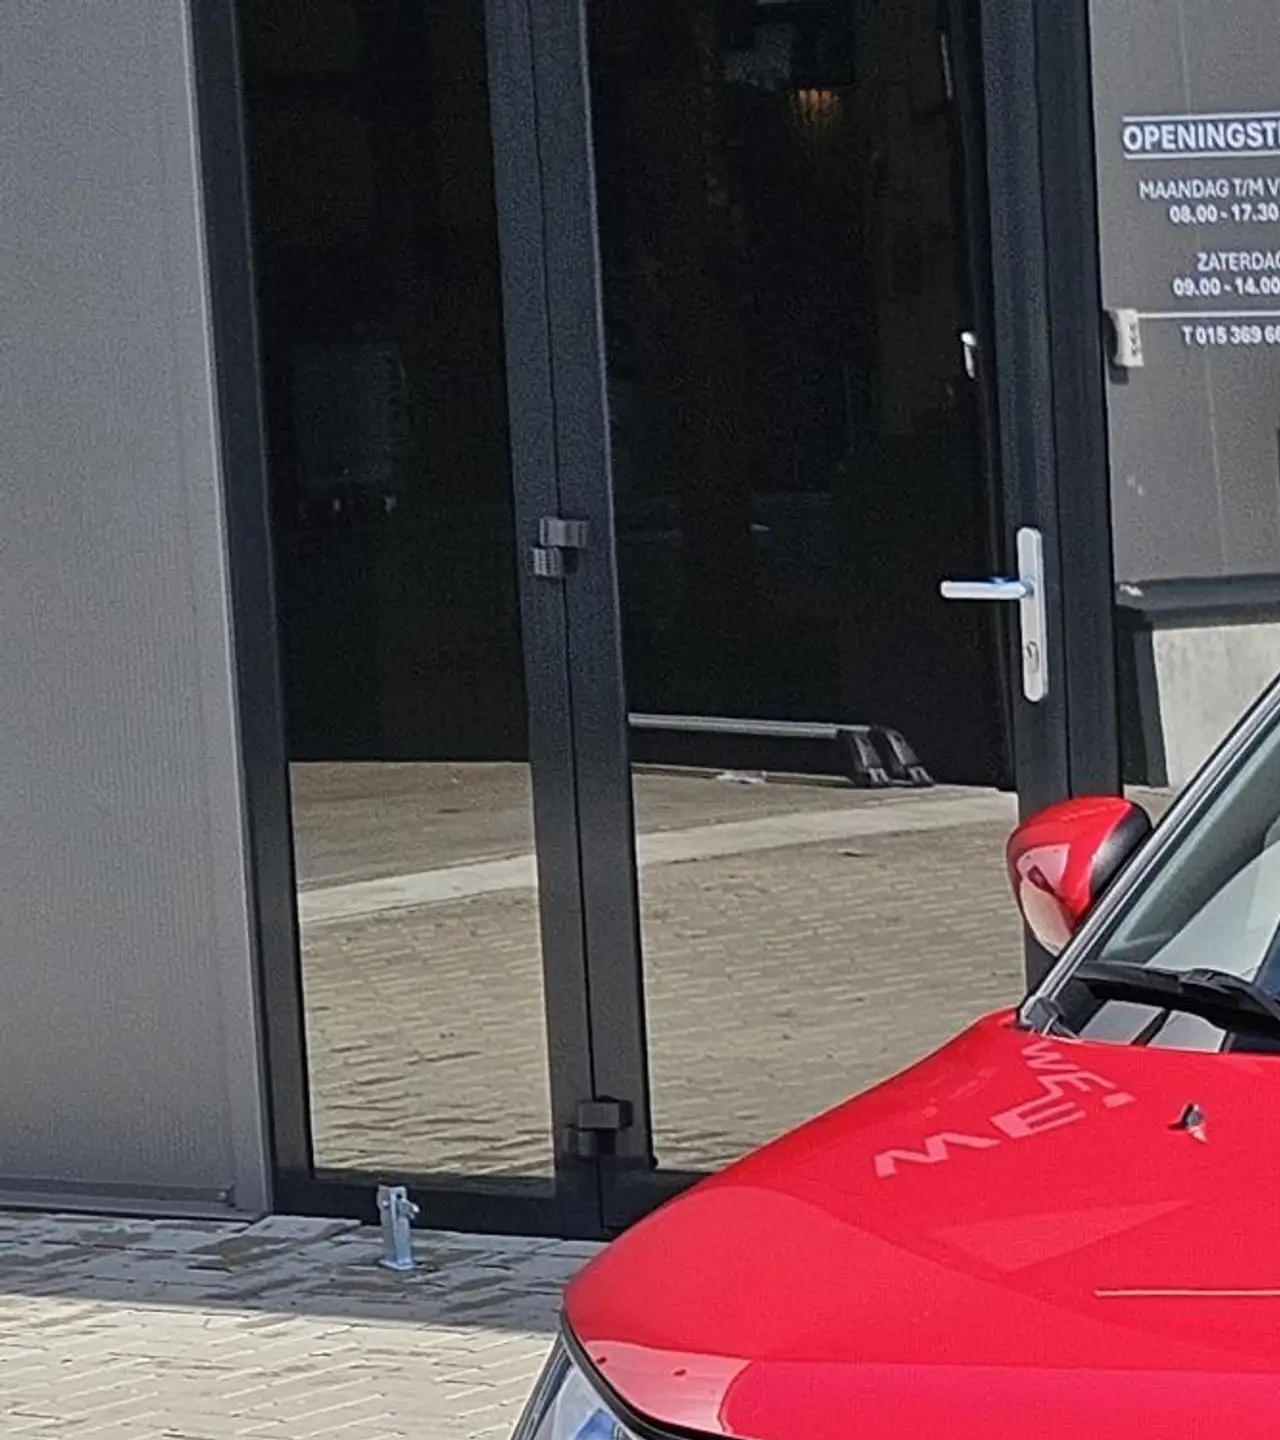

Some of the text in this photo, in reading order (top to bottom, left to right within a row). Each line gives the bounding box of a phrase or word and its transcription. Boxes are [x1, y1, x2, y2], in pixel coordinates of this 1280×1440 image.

[1138, 178, 1230, 199] MAANDAG
[1233, 176, 1264, 198] T/M
[1230, 202, 1280, 222] 17.30
[1172, 276, 1221, 297] 09.00
[1181, 325, 1193, 345] T
[1195, 325, 1227, 345] 015
